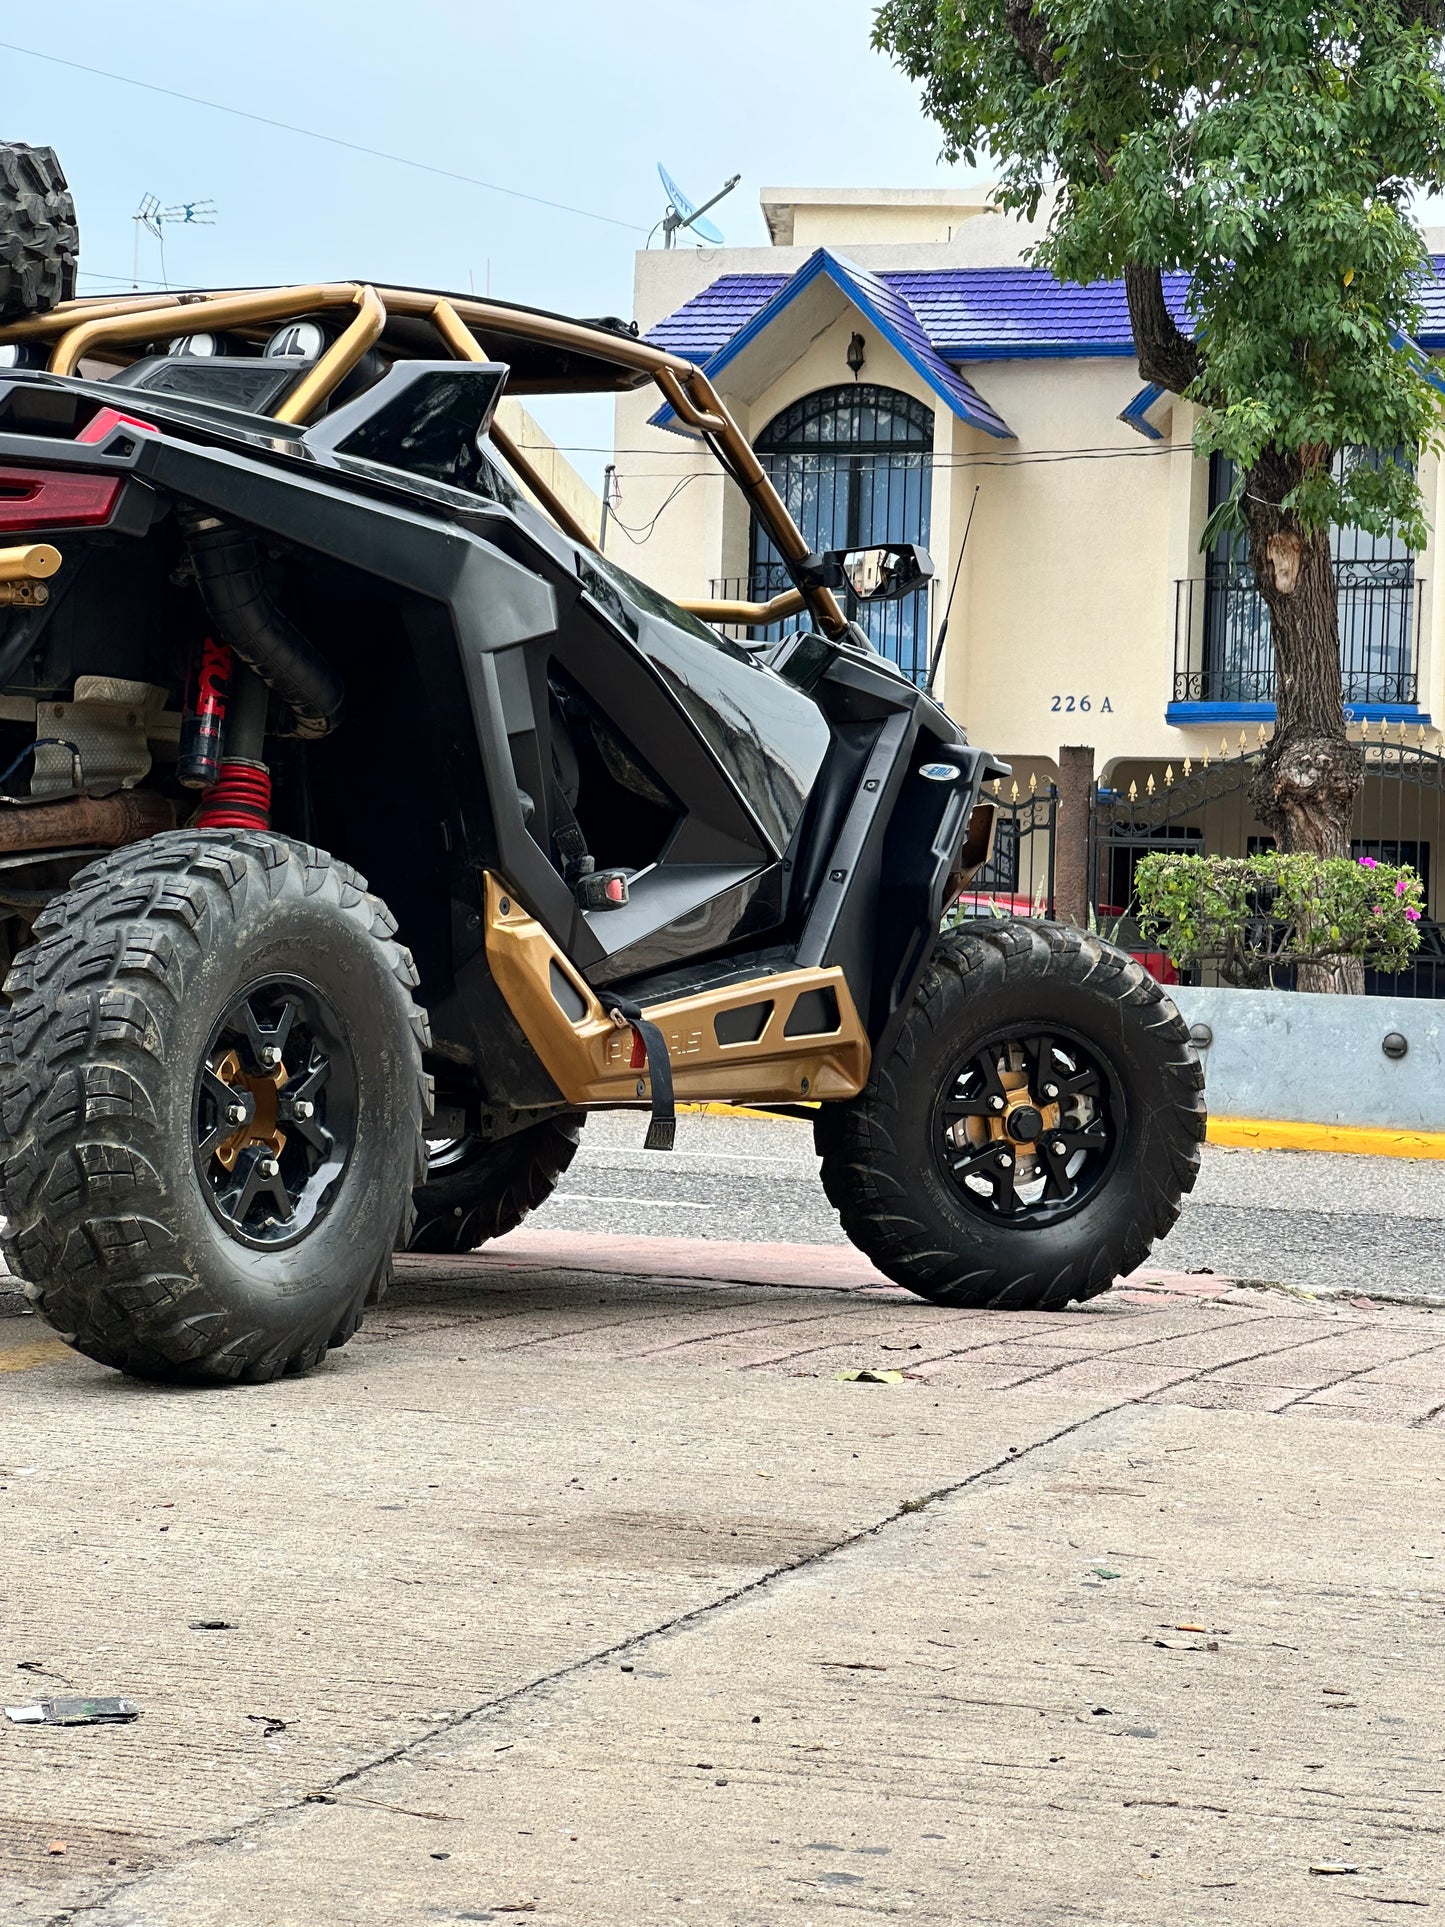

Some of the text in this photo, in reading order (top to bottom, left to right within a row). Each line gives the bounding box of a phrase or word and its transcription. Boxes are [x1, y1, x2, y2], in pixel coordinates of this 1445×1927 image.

[196, 637, 232, 720] FOX
[1051, 695, 1114, 713] 226 A
